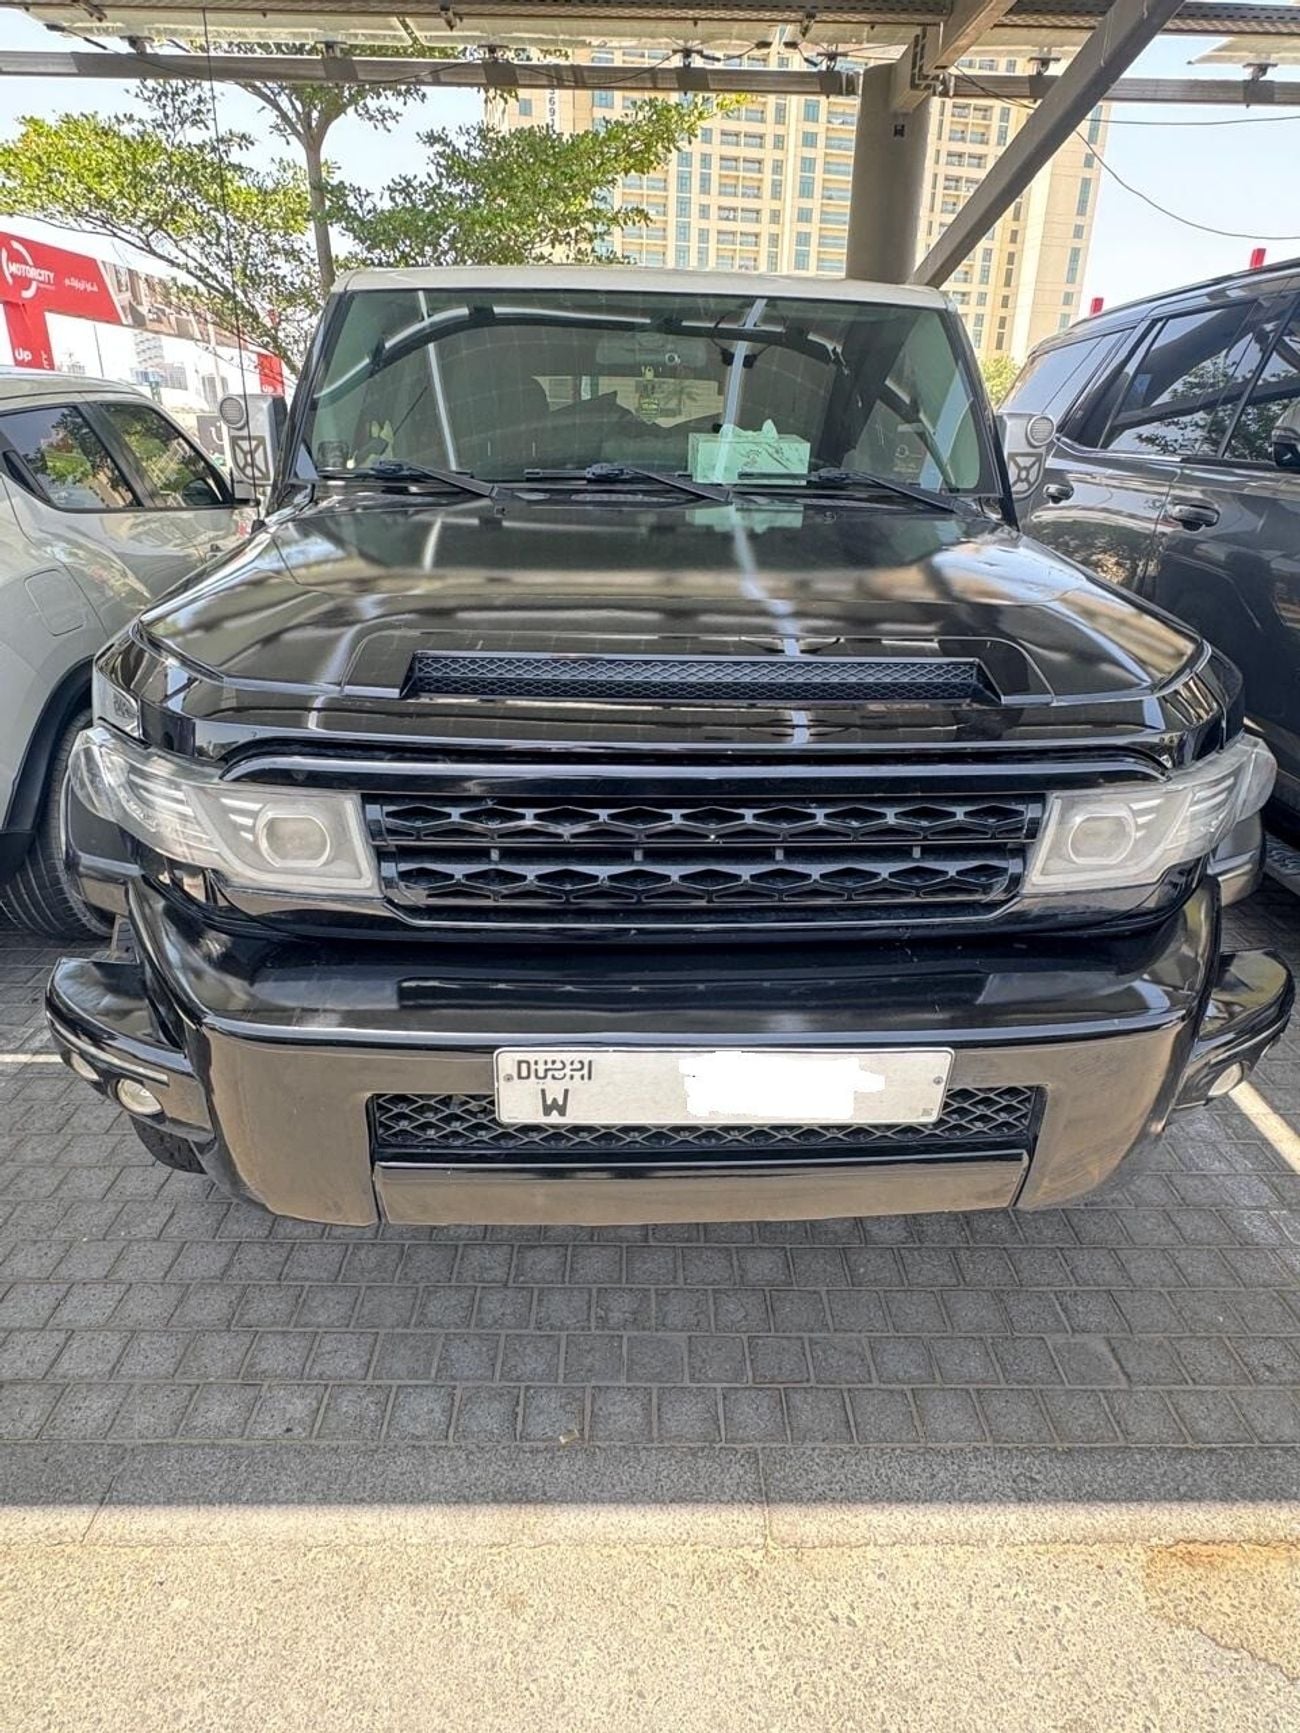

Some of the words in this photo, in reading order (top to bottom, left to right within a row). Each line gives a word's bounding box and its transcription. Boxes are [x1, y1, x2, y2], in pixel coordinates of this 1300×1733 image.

[8, 261, 55, 284] MOTORCITY
[516, 1059, 593, 1081] DUBAI
[540, 1088, 570, 1117] W
